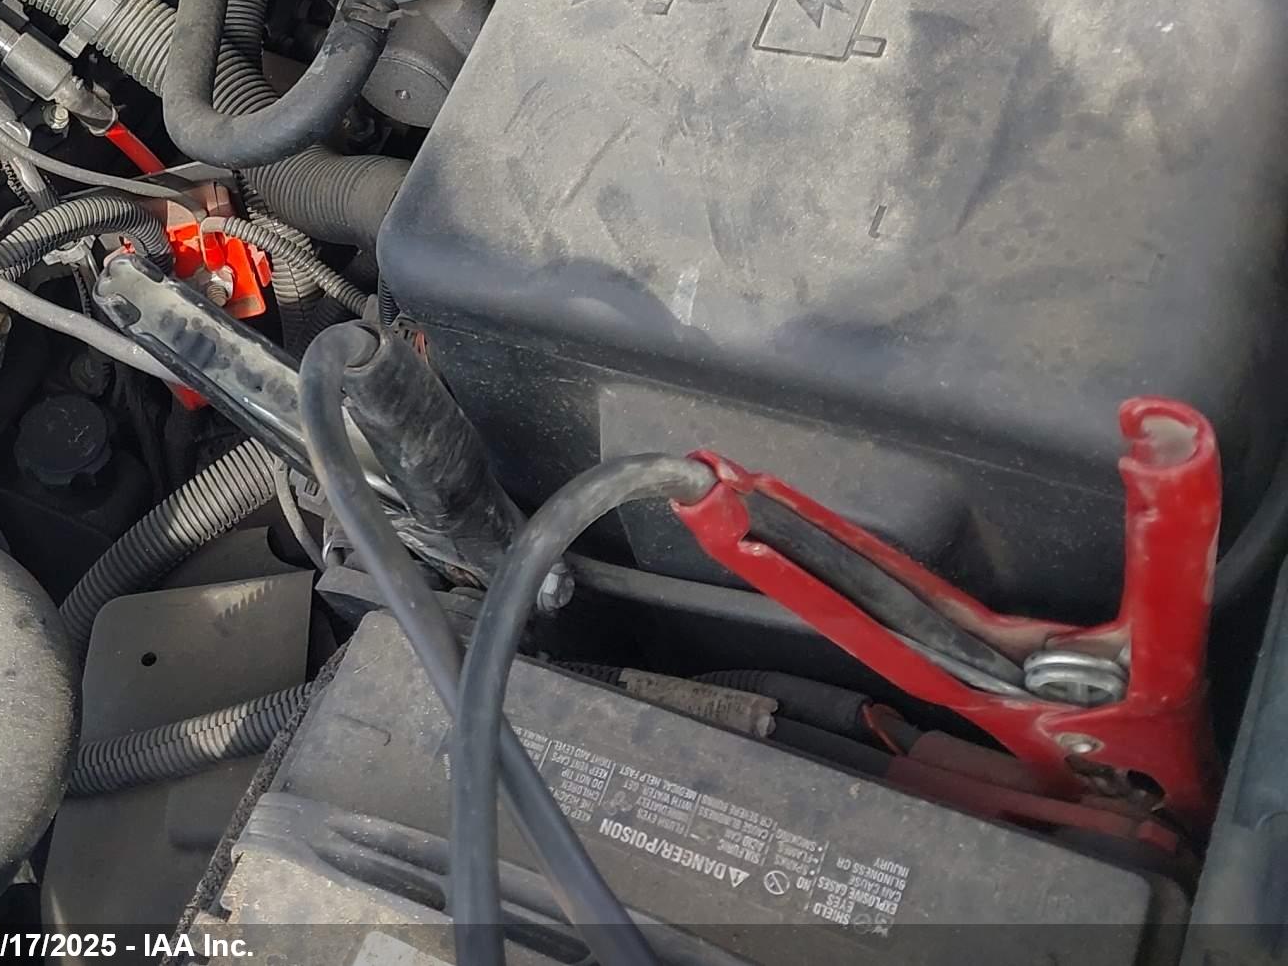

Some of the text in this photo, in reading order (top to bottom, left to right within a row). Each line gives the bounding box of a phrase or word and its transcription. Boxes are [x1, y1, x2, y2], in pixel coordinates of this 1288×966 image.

[574, 747, 591, 760] AND
[588, 765, 608, 779] KEEP
[639, 771, 660, 787] HELP
[590, 778, 603, 790] DO
[623, 778, 639, 792] GET
[578, 798, 594, 812] THE
[670, 796, 693, 812] WITH
[571, 808, 591, 822] KEEP
[636, 808, 657, 823] EYES
[741, 822, 768, 839] CAUSE
[598, 816, 726, 879] DANGER/POISON
[741, 835, 765, 851] ACID
[836, 857, 906, 890] BLINDNESS OR
[873, 857, 909, 877] INJURY
[795, 876, 811, 891] NO
[848, 874, 901, 902] CAN CAUSE
[817, 876, 897, 914] EXPLOSIVE GASES
[825, 893, 854, 912] EYES
[813, 902, 850, 923] SHIELD
